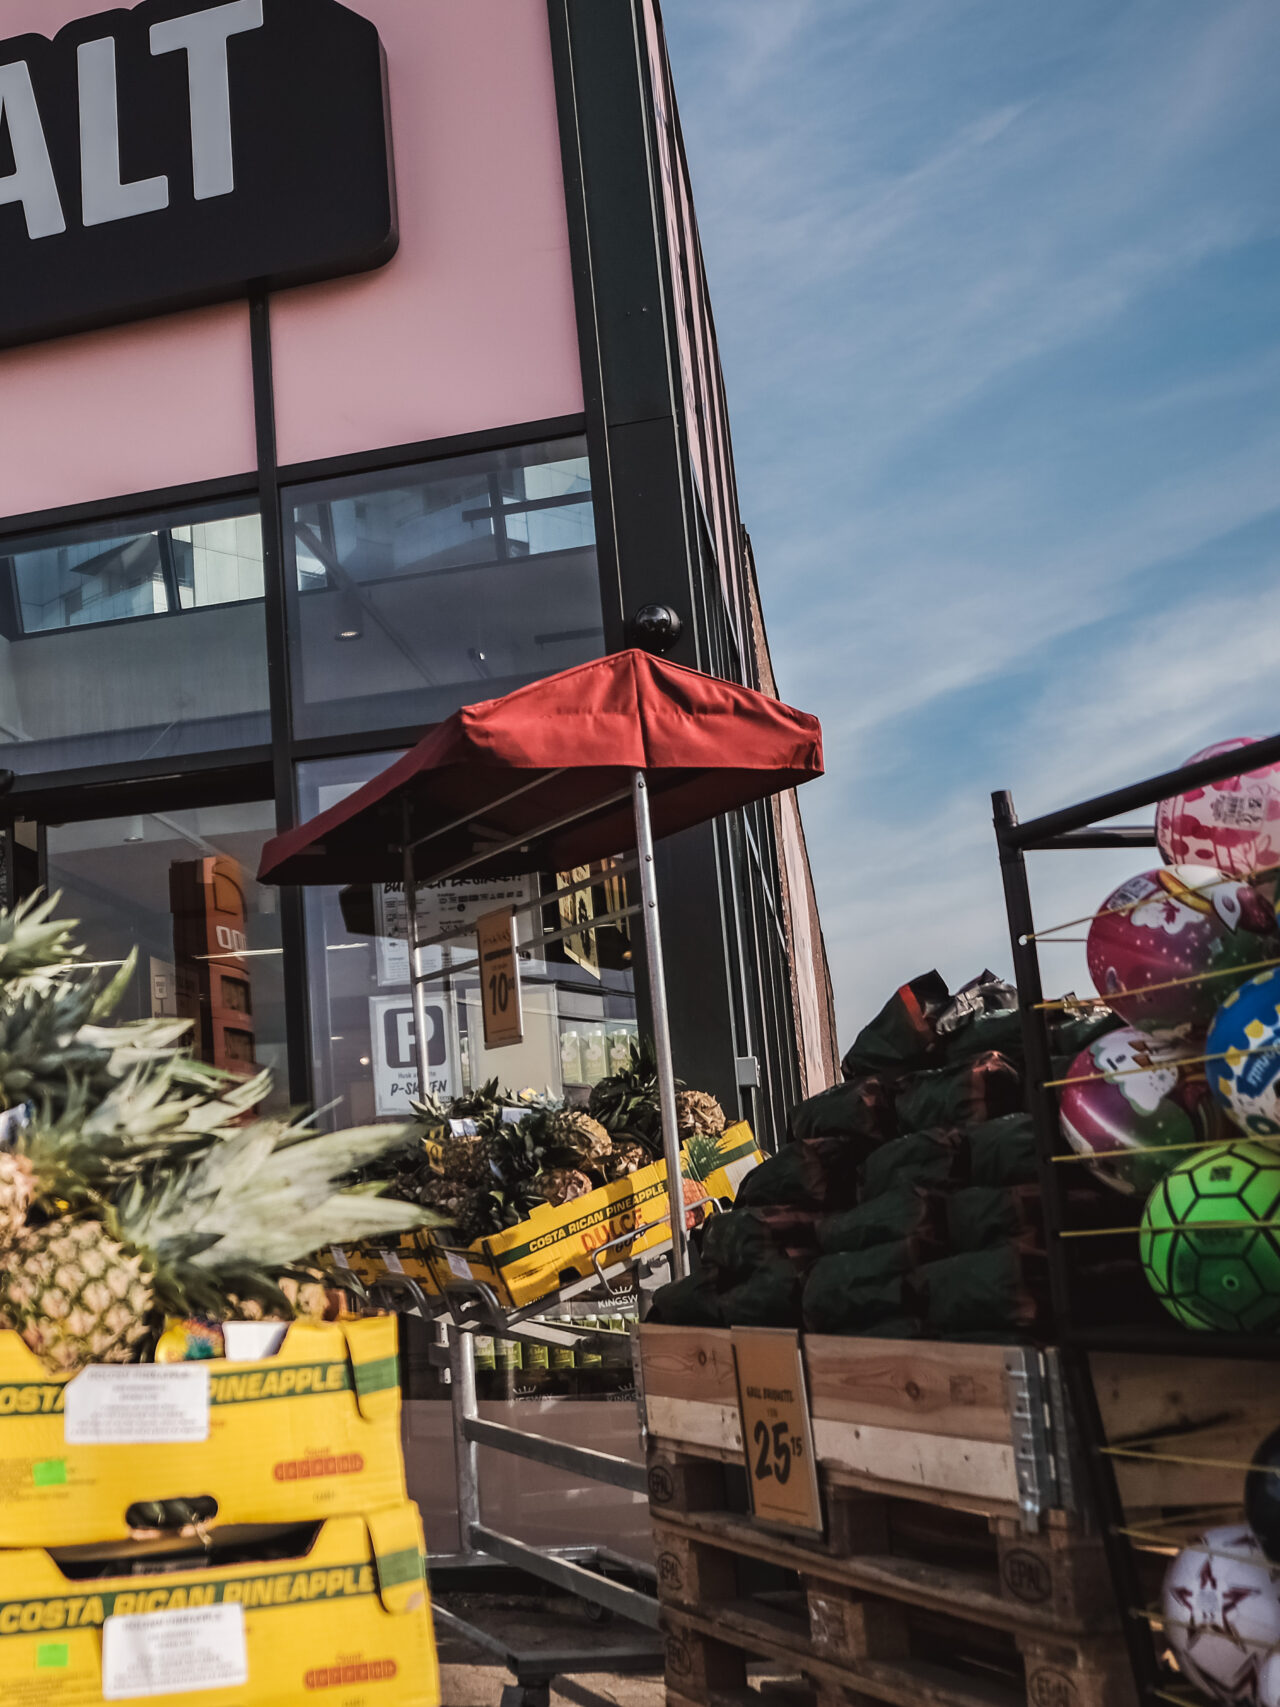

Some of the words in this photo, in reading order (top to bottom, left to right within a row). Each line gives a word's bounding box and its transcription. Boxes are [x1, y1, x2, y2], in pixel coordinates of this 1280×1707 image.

[489, 972, 508, 1015] 10
[390, 1080, 447, 1097] P-SKEN
[529, 1229, 567, 1253] COSTA
[568, 1207, 605, 1236] RICAN
[606, 1182, 665, 1218] PINEAPPLE
[754, 1421, 791, 1485] 25
[222, 1566, 376, 1609] PINEAPPLE
